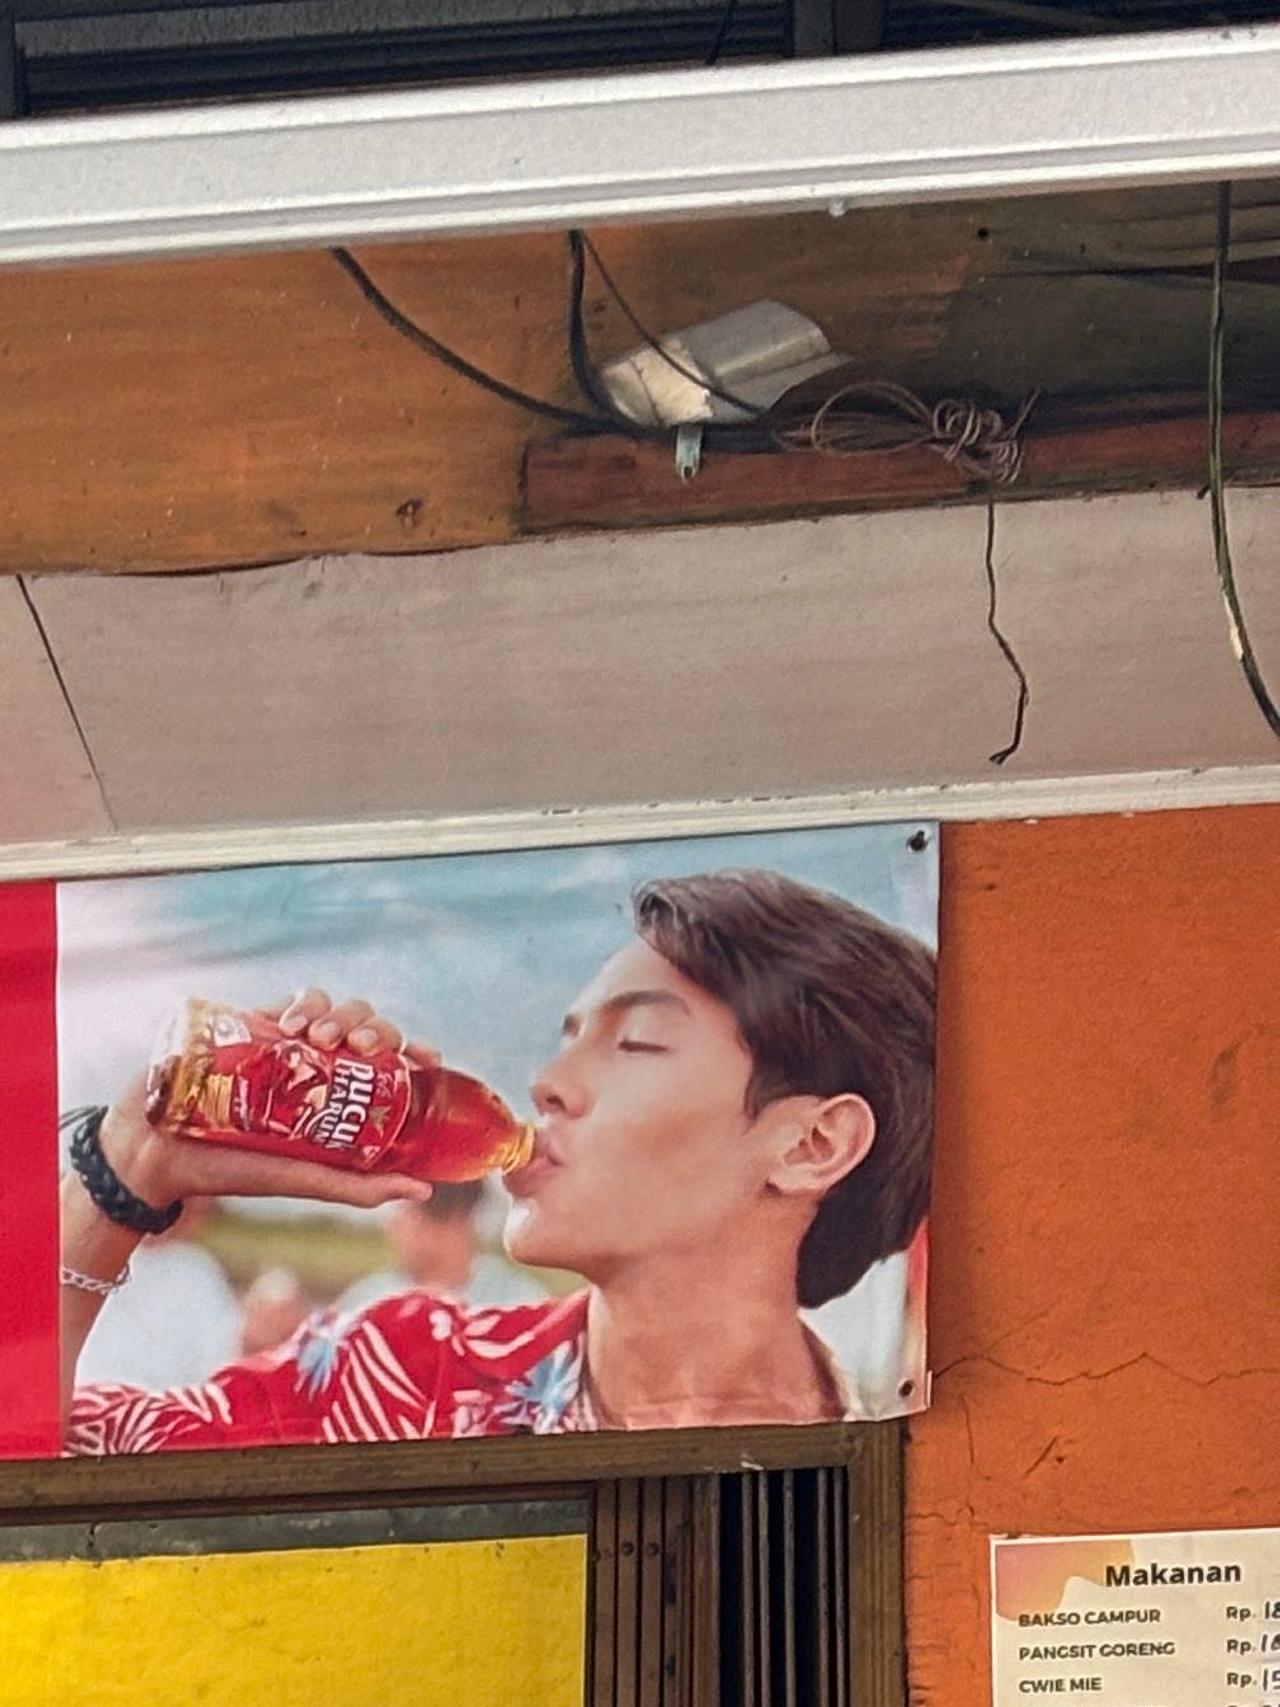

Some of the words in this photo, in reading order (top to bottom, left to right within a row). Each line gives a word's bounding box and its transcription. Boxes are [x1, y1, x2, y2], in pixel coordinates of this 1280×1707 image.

[1105, 1562, 1241, 1587] Makanan
[1018, 1612, 1081, 1627] BAKSO
[1084, 1609, 1161, 1625] CAMPUR
[1019, 1644, 1096, 1660] PANGSIT
[1098, 1642, 1176, 1657] GORENG
[1019, 1679, 1066, 1693] CWIE
[1069, 1677, 1102, 1691] MIE
